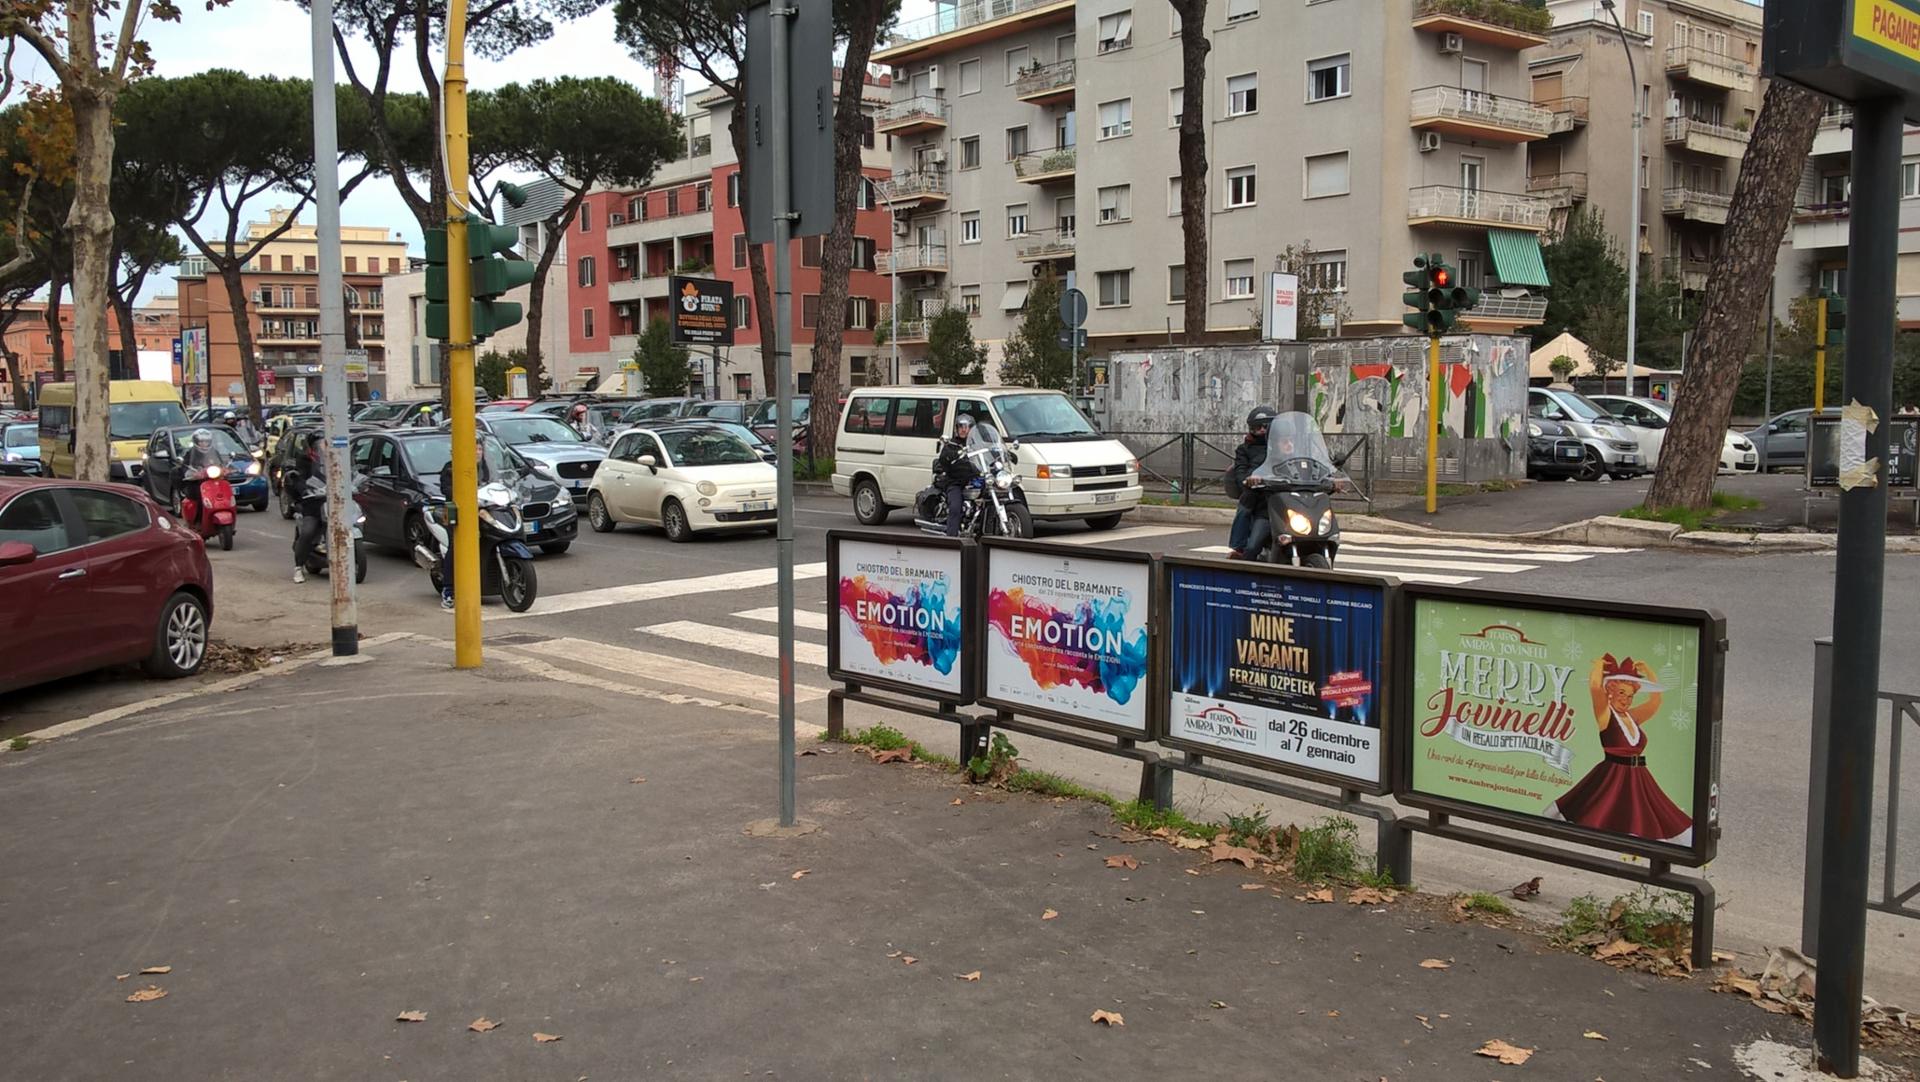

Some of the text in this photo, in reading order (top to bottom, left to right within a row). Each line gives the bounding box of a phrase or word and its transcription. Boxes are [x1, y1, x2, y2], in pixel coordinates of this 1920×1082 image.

[857, 563, 889, 575] CHIOSTRO
[890, 566, 903, 576] DEL
[905, 568, 944, 580] BRAMANTE
[1012, 573, 1123, 597] CHIOSTRO DEL BRAMANTE
[856, 600, 944, 631] EMOTION
[1251, 613, 1295, 644] MINE
[1011, 615, 1121, 655] EMOTION
[1459, 638, 1547, 658] AMBRA JOVINELLI
[1236, 639, 1309, 674] VAGANTI
[1229, 667, 1267, 687] FERZAN
[1270, 674, 1316, 696] OZPETEK
[1440, 650, 1575, 710] MERRY
[1420, 687, 1575, 741] Jovinelli
[1184, 718, 1214, 732] AMBRA
[1216, 724, 1257, 740] JOVINELLI
[1268, 719, 1370, 750] dal 26 dicembre
[1461, 727, 1555, 755] UN REGALO SPETTACOLARE
[1280, 736, 1356, 764] al 7 gennaio
[1448, 775, 1543, 800] www.ambrajovinelli.org
